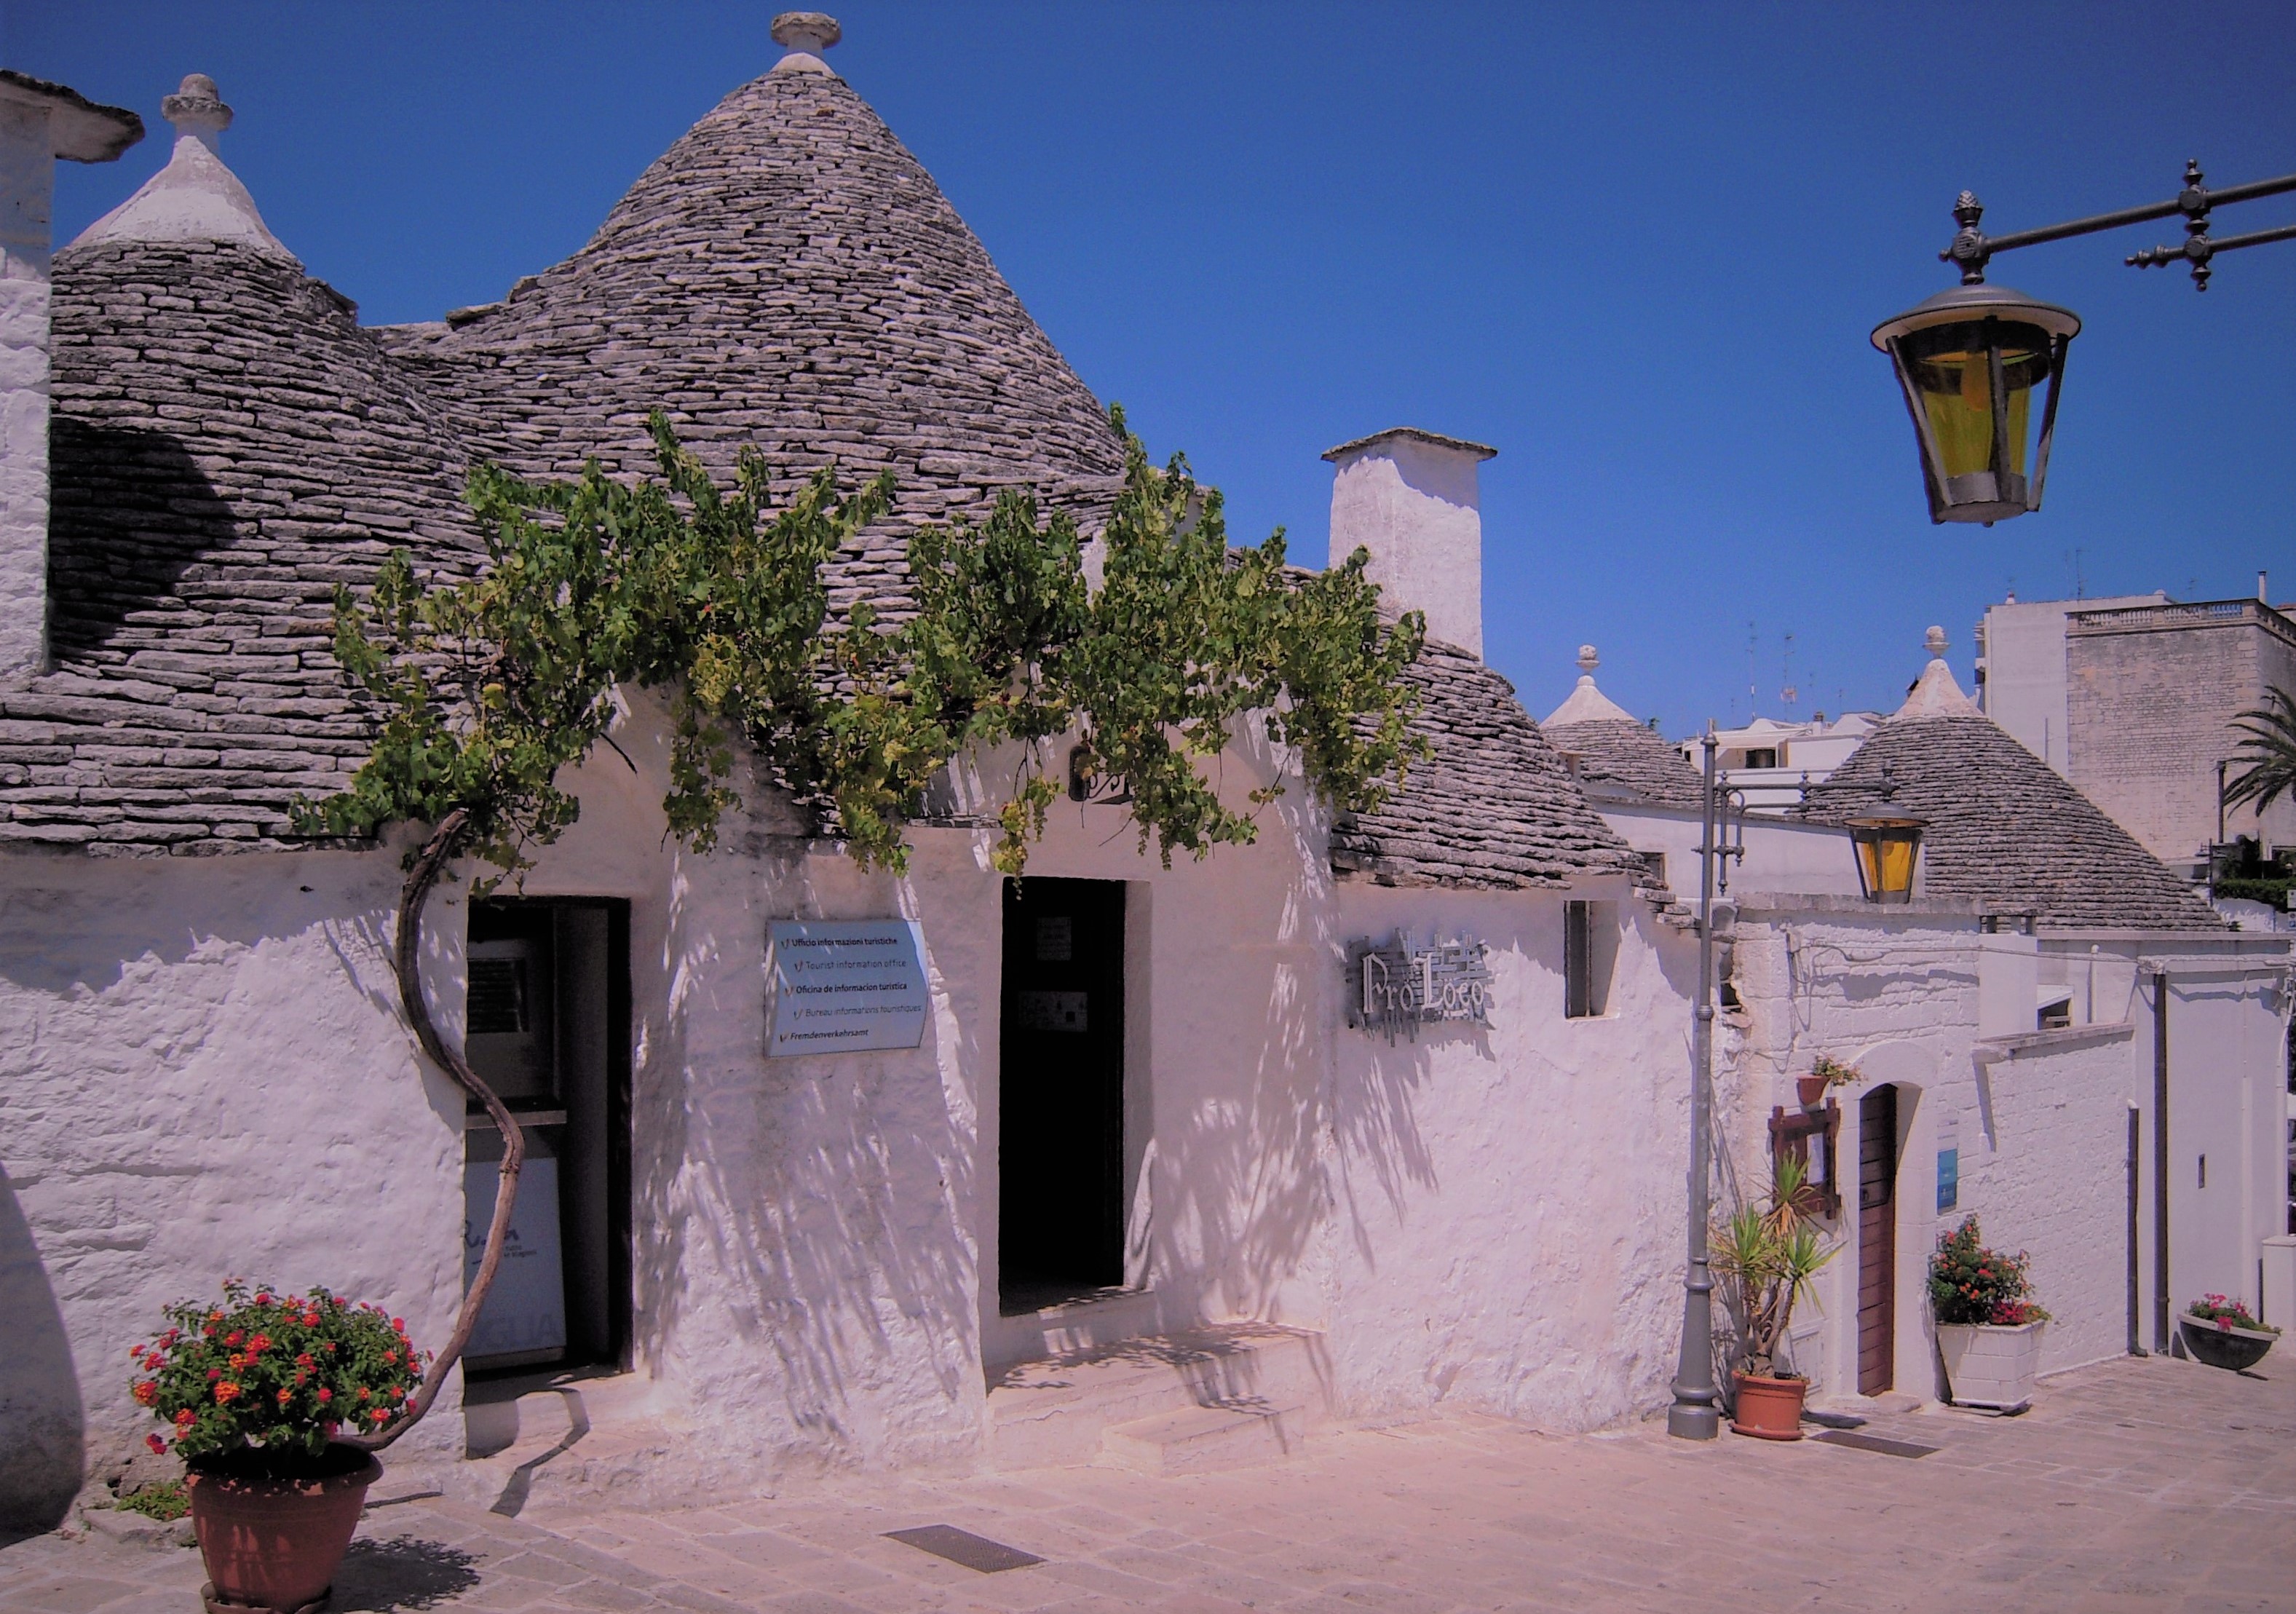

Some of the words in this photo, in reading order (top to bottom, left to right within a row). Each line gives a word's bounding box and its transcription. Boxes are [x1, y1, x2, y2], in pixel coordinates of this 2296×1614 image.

[791, 938, 816, 947] Ufficio
[818, 938, 863, 946] informazioni
[864, 937, 898, 945] turistiche
[806, 960, 834, 970] Tourist
[836, 960, 882, 969] information
[884, 959, 906, 968] office
[1361, 952, 1414, 1013] Pro
[1412, 952, 1484, 1010] Loco
[796, 985, 822, 994] Oficina
[823, 985, 833, 993] de
[805, 1008, 833, 1017] Bureau
[834, 1006, 879, 1016] informations
[879, 1004, 922, 1013] touristiques
[789, 1029, 868, 1040] Fremdenverkehrsamt
